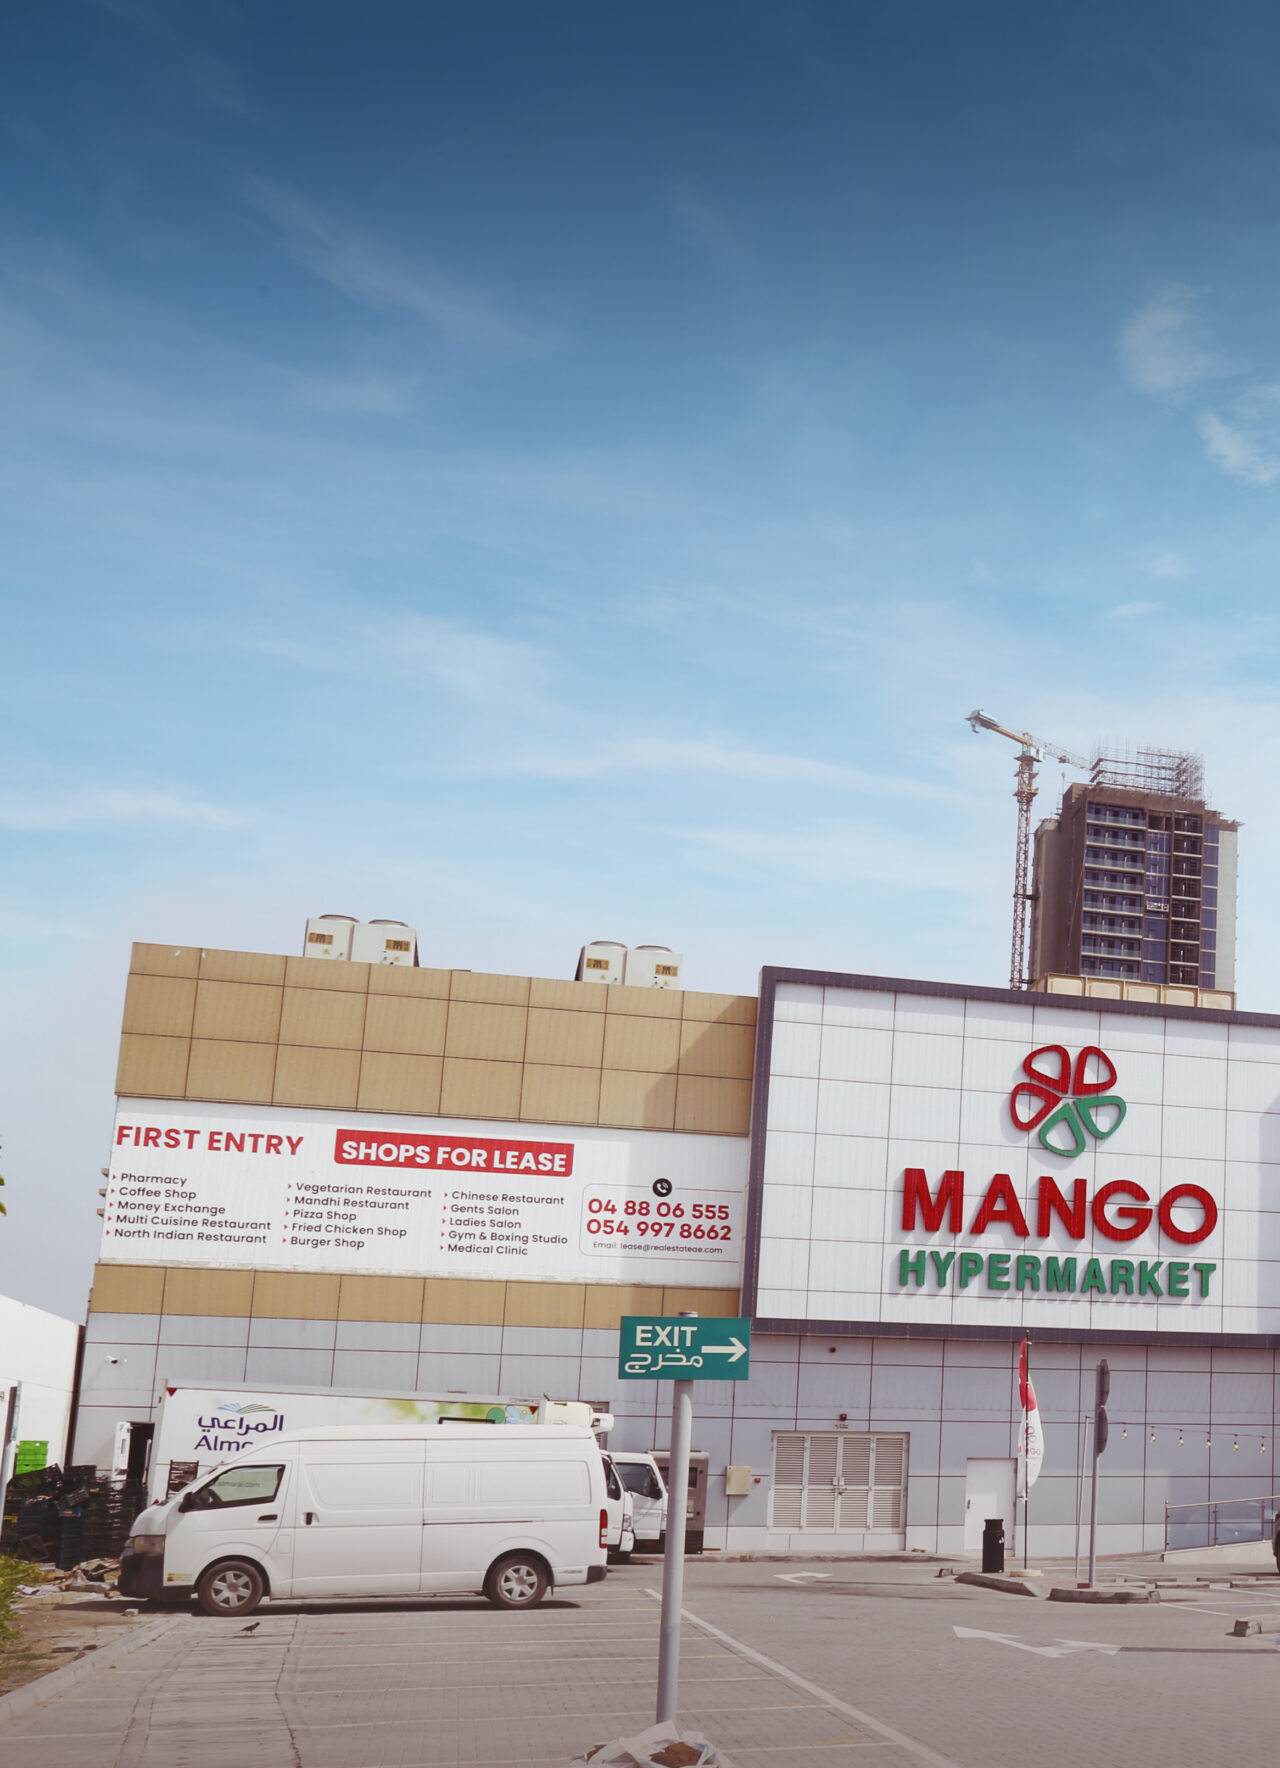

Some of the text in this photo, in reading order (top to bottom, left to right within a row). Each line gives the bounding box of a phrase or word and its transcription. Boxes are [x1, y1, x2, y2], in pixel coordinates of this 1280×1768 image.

[116, 1125, 304, 1155] FIRST ENTRY
[341, 1140, 567, 1172] SHOPS FOR LEASE
[120, 1173, 187, 1187] Pharmacy
[119, 1186, 196, 1201] Coffee Shop
[296, 1182, 432, 1198] Vegetarian Restaurant
[451, 1191, 564, 1205] Chinese Restaurant
[117, 1201, 226, 1216] Money Exchange
[294, 1196, 409, 1210] Mandhi Restaurant
[450, 1204, 519, 1216] Gents Salon
[588, 1198, 729, 1220] 04 88 06 555
[901, 1167, 1218, 1245] MANGO
[116, 1214, 271, 1230] Multi Cuisine Restaurant
[293, 1209, 357, 1223] Pizza Shop
[449, 1217, 522, 1229] Ladies Salon
[114, 1228, 267, 1244] North Indian Restaurant
[291, 1222, 407, 1239] Fried Chicken Shop
[448, 1230, 568, 1245] Gym & Boxing Studio
[586, 1218, 732, 1241] 054 997 8662
[290, 1236, 365, 1250] Burger Shop
[447, 1243, 528, 1256] Medical Clinic
[899, 1249, 1217, 1298] HYPERMARKET
[635, 1325, 698, 1347] EXIT
[624, 1348, 703, 1373] مخرج
[198, 1414, 284, 1436] المراعي
